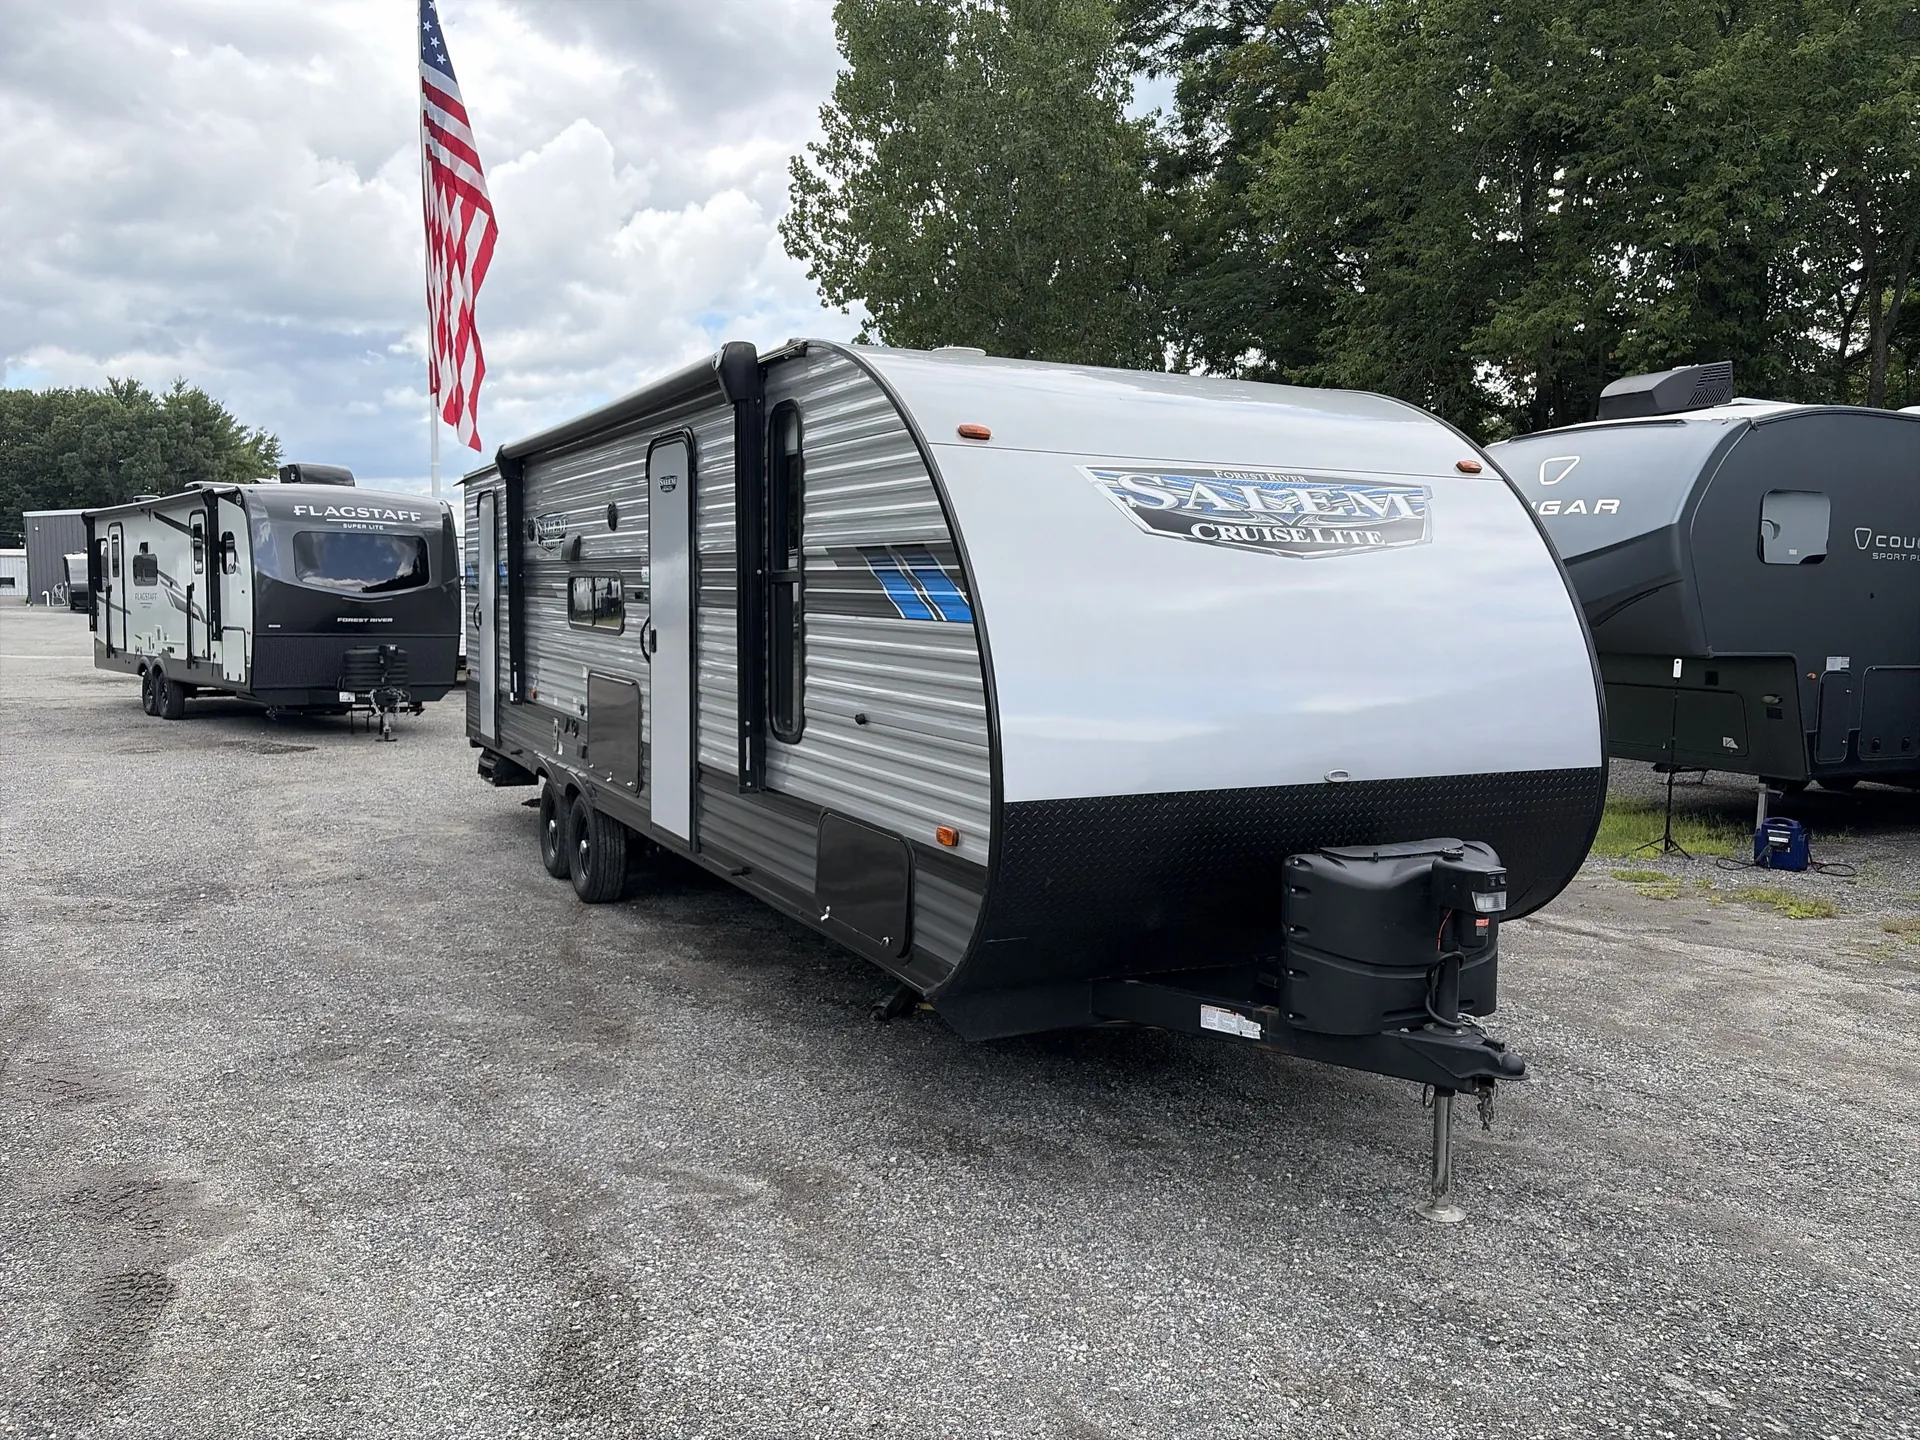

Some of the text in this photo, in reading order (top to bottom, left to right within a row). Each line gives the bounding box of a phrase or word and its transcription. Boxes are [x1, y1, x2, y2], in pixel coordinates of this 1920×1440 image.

[1213, 470, 1308, 483] FOREST RIVER
[1117, 474, 1424, 519] SALEM
[293, 505, 422, 522] FLAGSTAFF
[1872, 552, 1907, 561] SPORT
